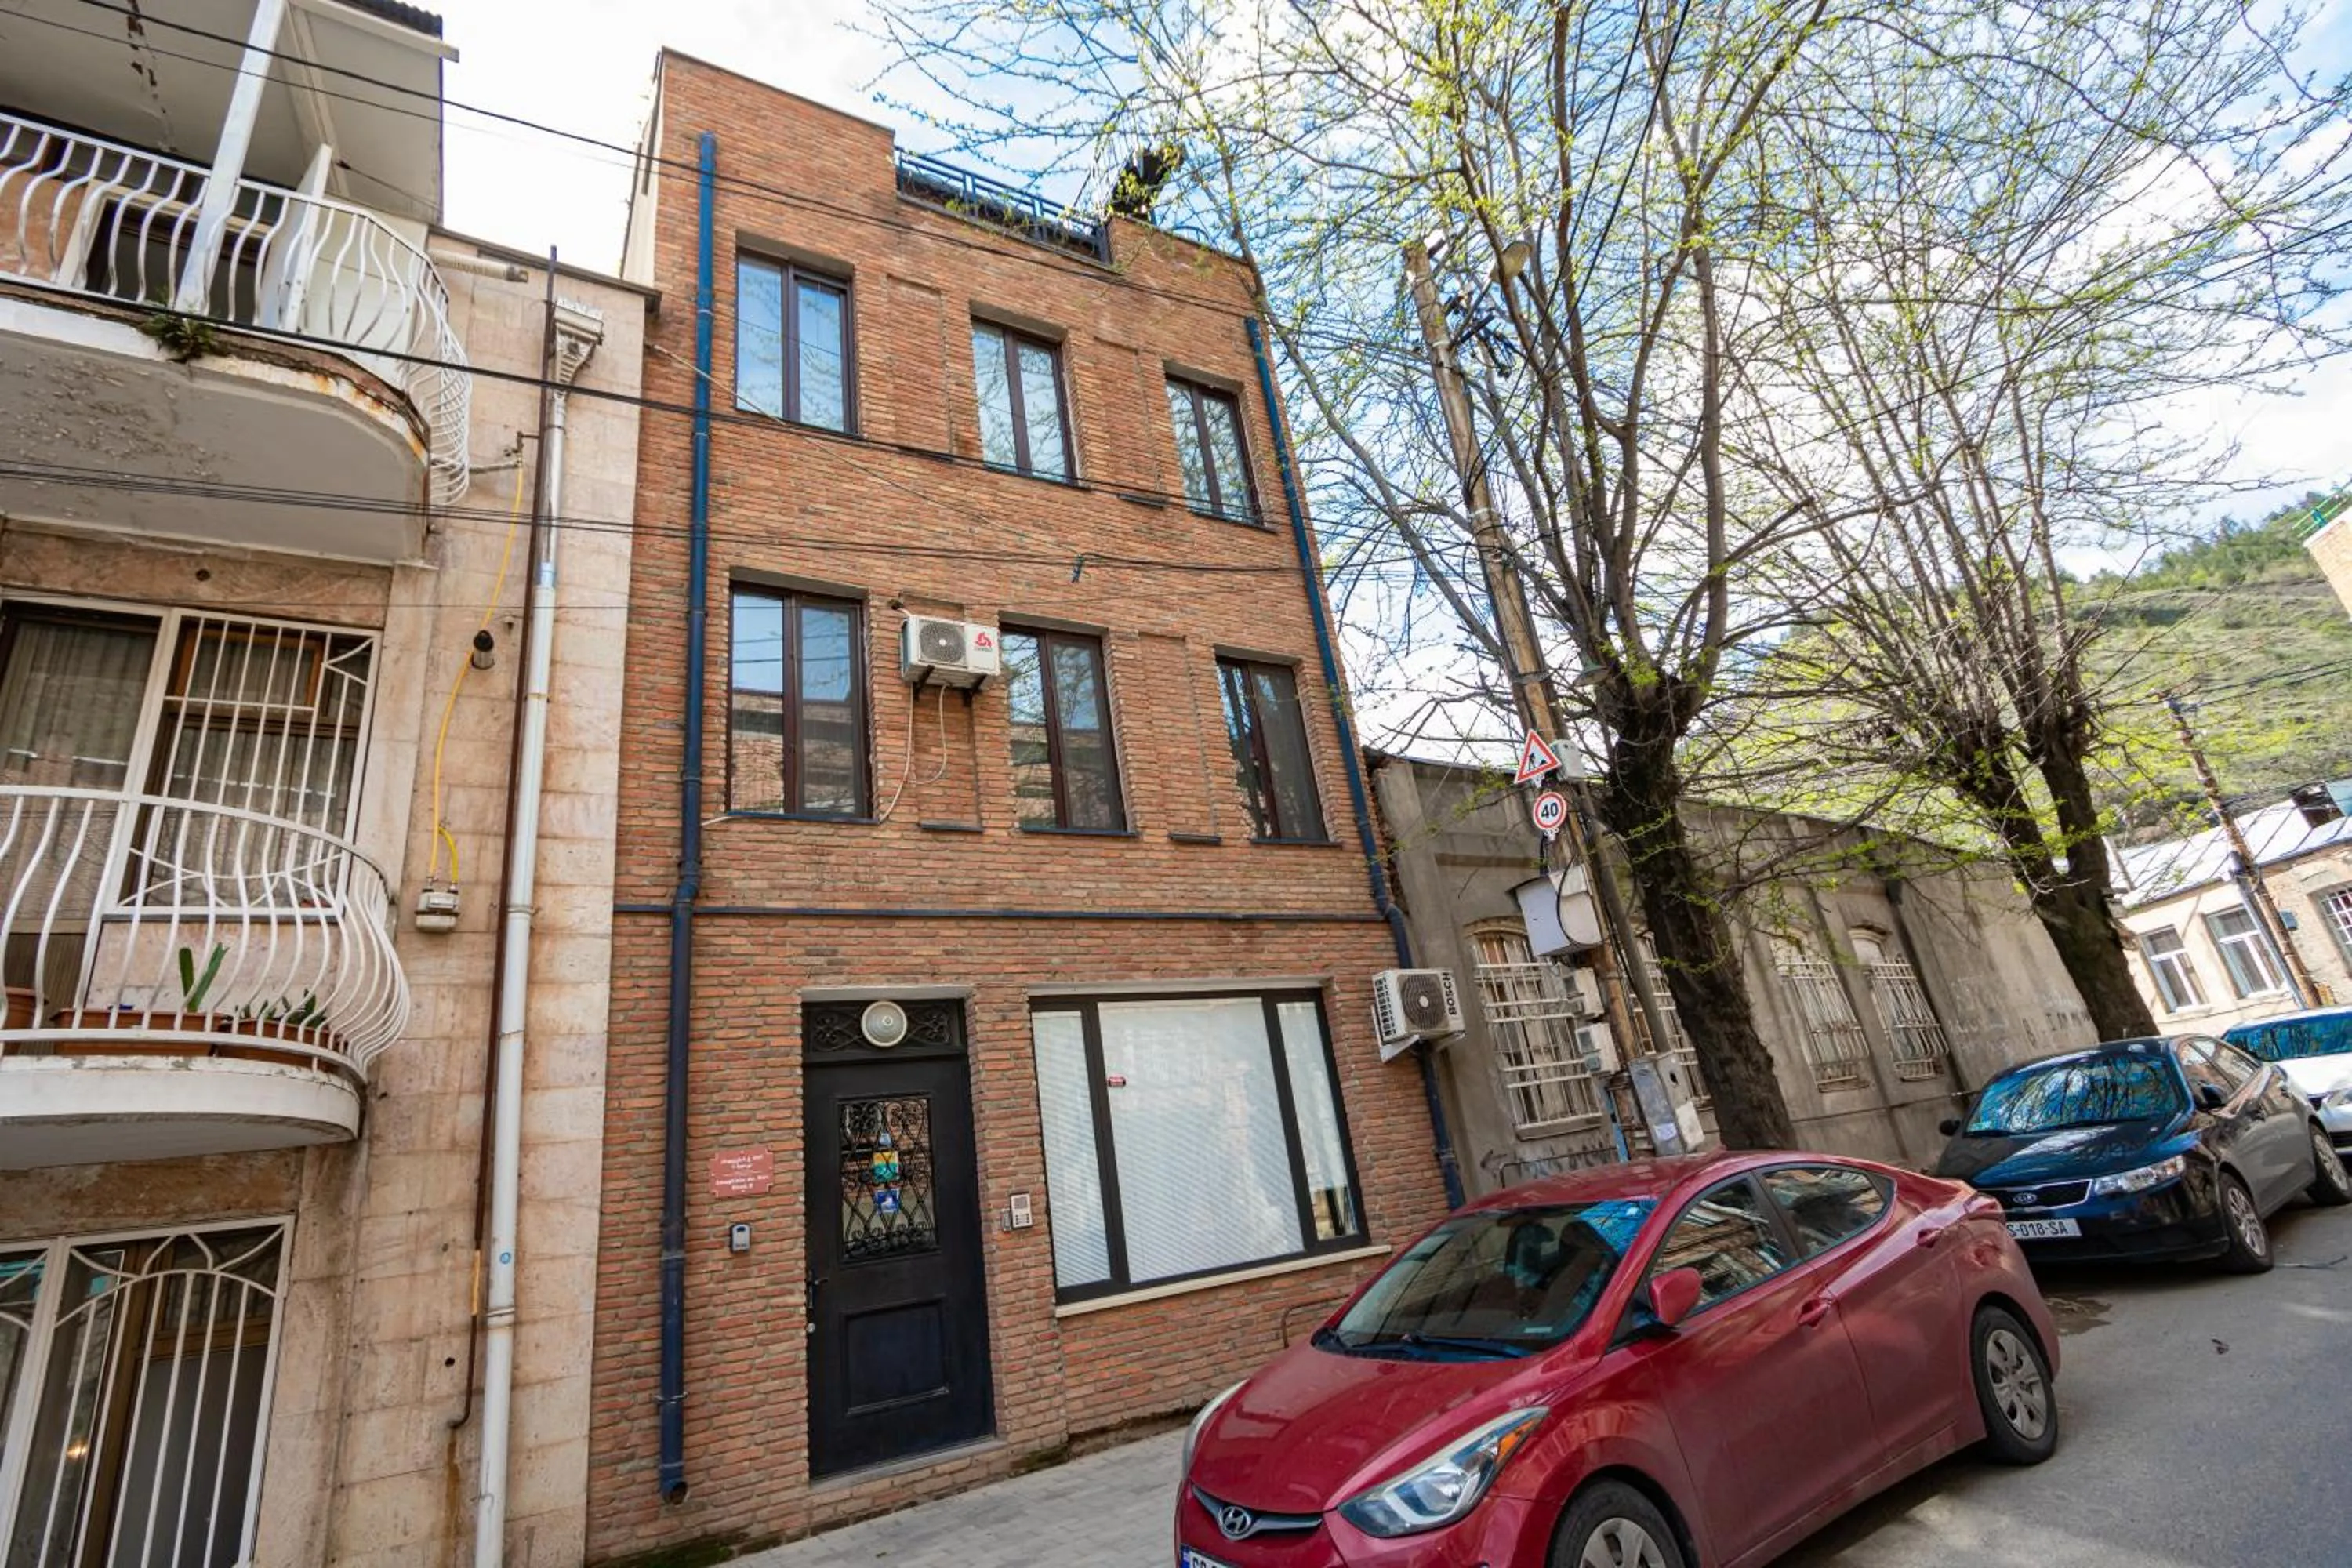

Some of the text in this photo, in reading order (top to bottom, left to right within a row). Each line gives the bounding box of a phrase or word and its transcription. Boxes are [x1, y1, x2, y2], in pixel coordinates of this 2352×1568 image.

[1541, 802, 1559, 818] 40
[1442, 971, 1457, 1015] BOSCH
[2007, 1221, 2068, 1236] S-018-SA
